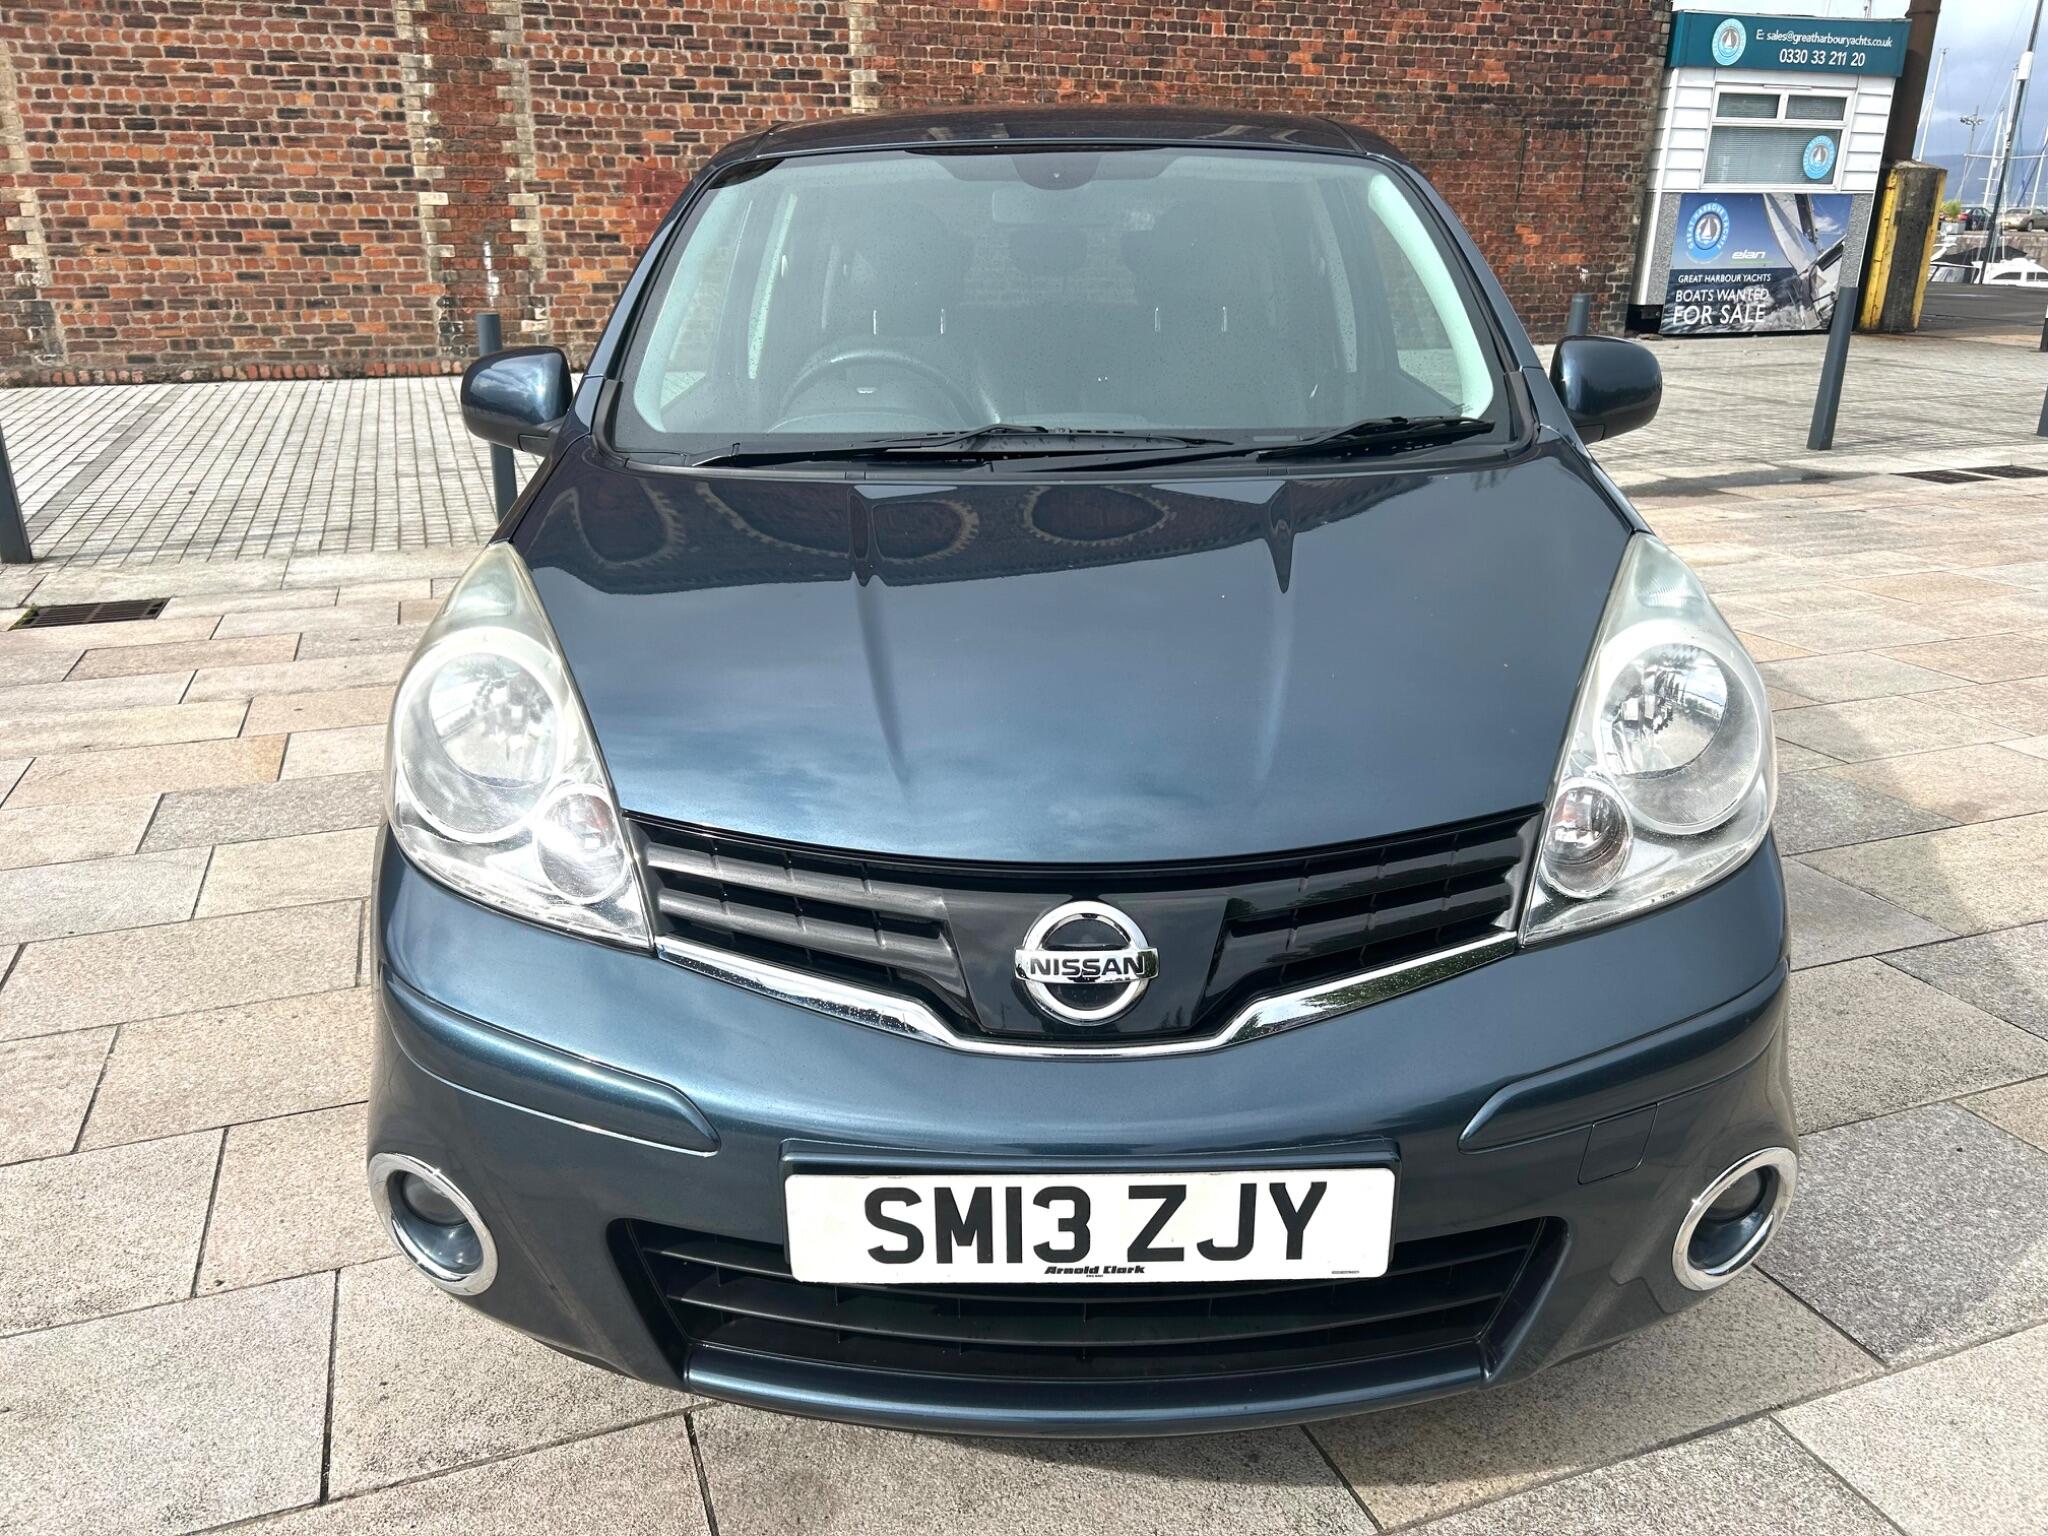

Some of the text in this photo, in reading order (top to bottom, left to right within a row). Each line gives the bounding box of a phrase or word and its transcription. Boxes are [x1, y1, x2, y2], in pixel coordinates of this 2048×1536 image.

[1766, 29, 1893, 48] sales@greatharbouryachts.co.uk
[1779, 48, 1866, 67] 0330 33 211 20
[1731, 249, 1766, 259] elan
[1678, 273, 1771, 283] GREAT HARBOUR YACHTS
[1675, 288, 1769, 303] BOATS WANTED
[1672, 303, 1766, 325] FOR SALE
[1030, 957, 1145, 976] NISSAN
[864, 1181, 1328, 1265] SM13 ZJY
[1044, 1265, 1146, 1275] Arnold Clark
